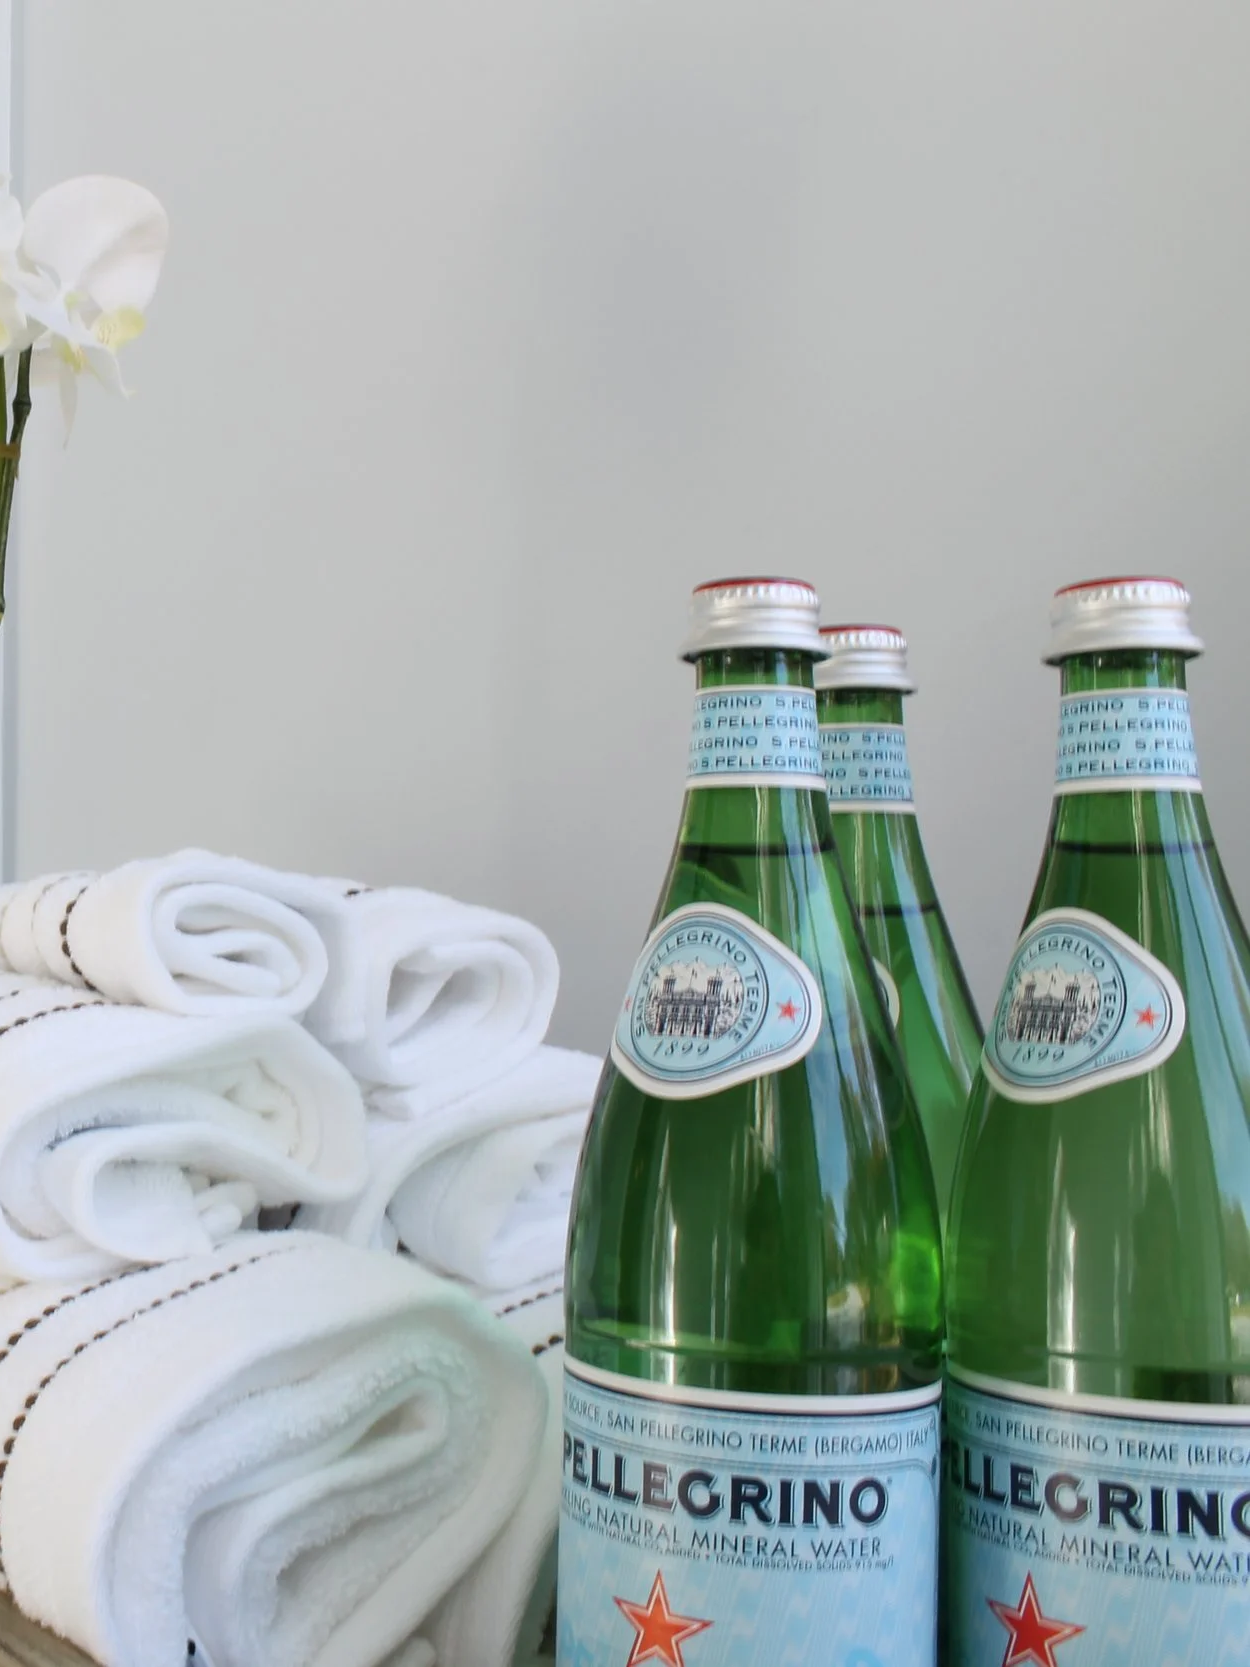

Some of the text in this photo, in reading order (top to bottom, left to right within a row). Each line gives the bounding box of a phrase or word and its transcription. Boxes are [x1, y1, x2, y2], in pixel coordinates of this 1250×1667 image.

[643, 929, 747, 987] PELLEGRINO
[732, 970, 760, 1043] TERME
[1007, 935, 1105, 992] PELLEGRINO
[1086, 975, 1118, 1048] TERME
[607, 1410, 635, 1433] SAN
[640, 1418, 742, 1449] PELLEGRINO
[750, 1431, 807, 1452] TERME
[814, 1431, 902, 1457] (BERGAMO)
[976, 1411, 1000, 1434] SAN
[1006, 1419, 1108, 1452] PELLEGRINO
[1116, 1438, 1178, 1462] TERME
[597, 1504, 681, 1545] NATURAL
[691, 1528, 799, 1558] MINERAL
[810, 1536, 881, 1560] WATER
[968, 1505, 1046, 1549] NATURAL
[1060, 1530, 1174, 1567] MINERAL
